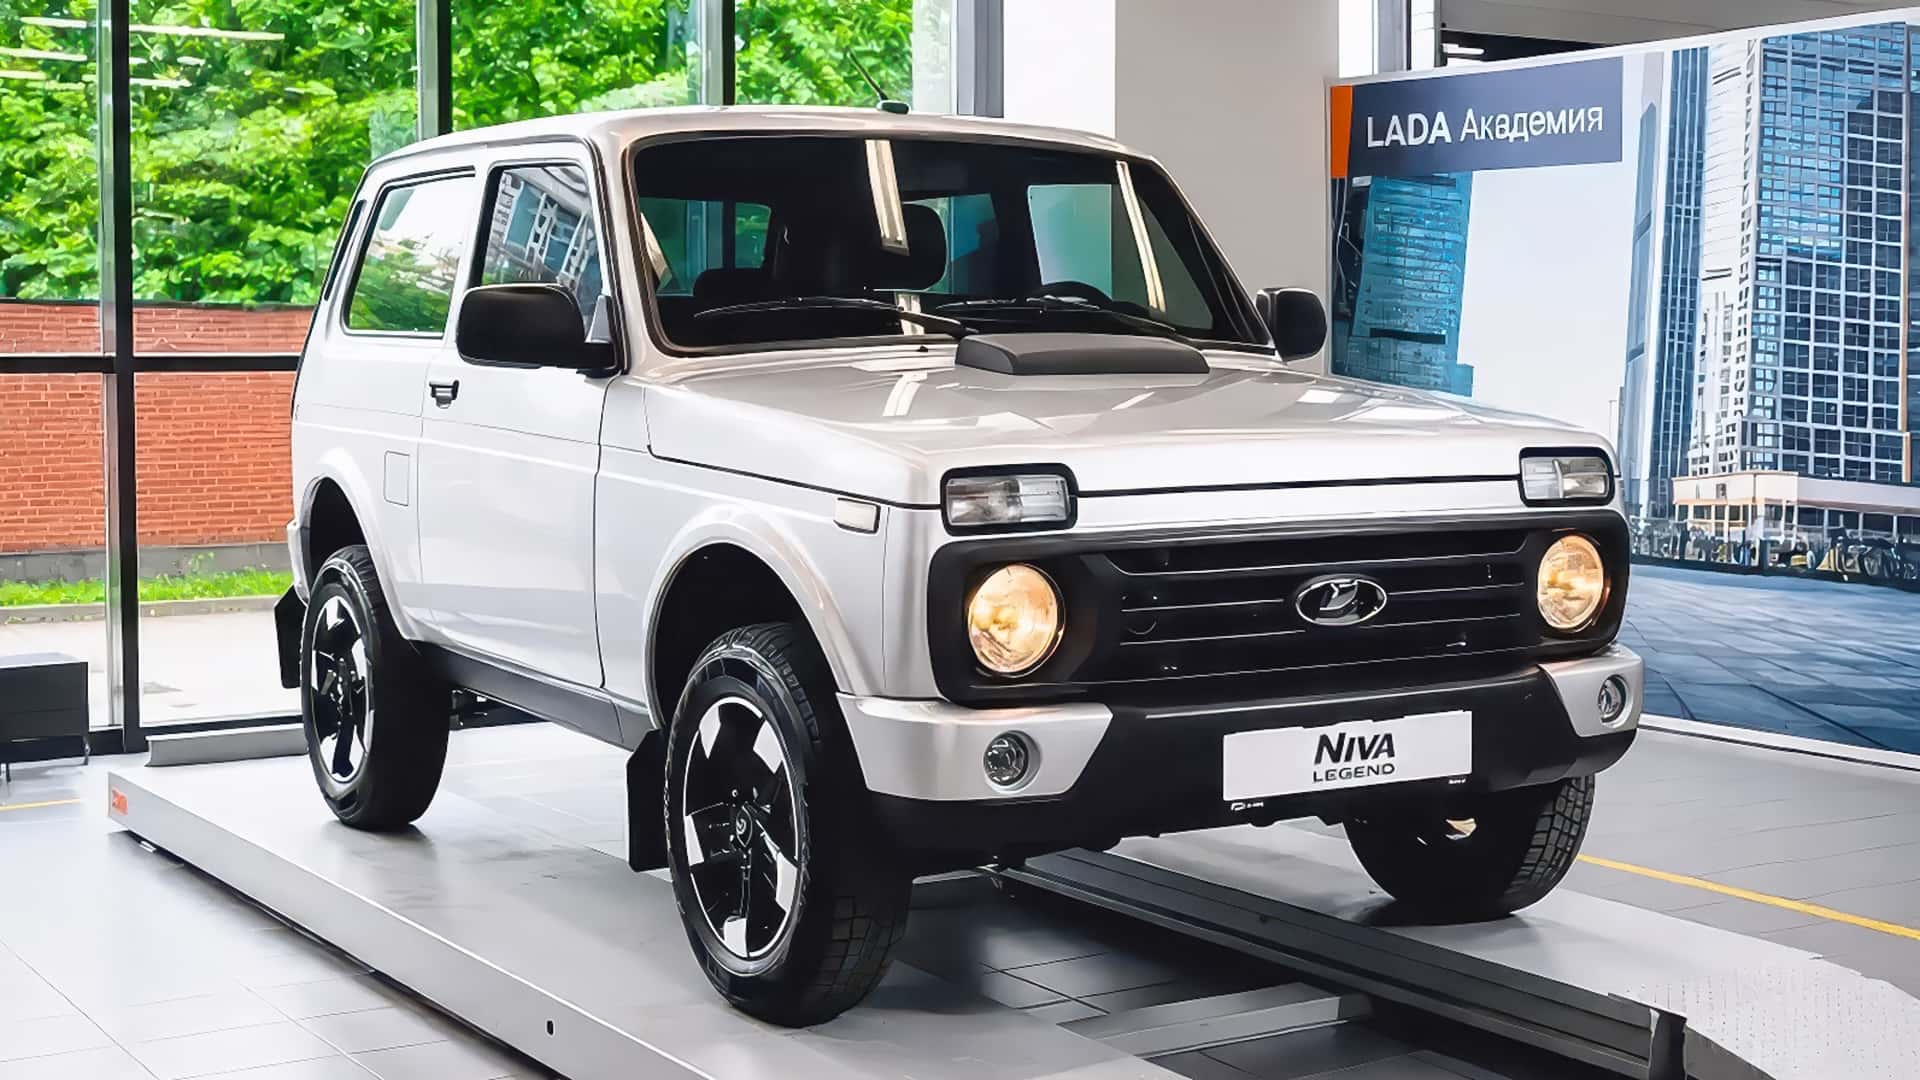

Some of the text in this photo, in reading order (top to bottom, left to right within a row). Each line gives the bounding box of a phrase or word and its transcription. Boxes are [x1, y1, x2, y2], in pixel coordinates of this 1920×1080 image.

[1367, 106, 1604, 148] LADA Академия
[1314, 732, 1396, 765] NIVA
[1313, 763, 1395, 783] LEGEND
